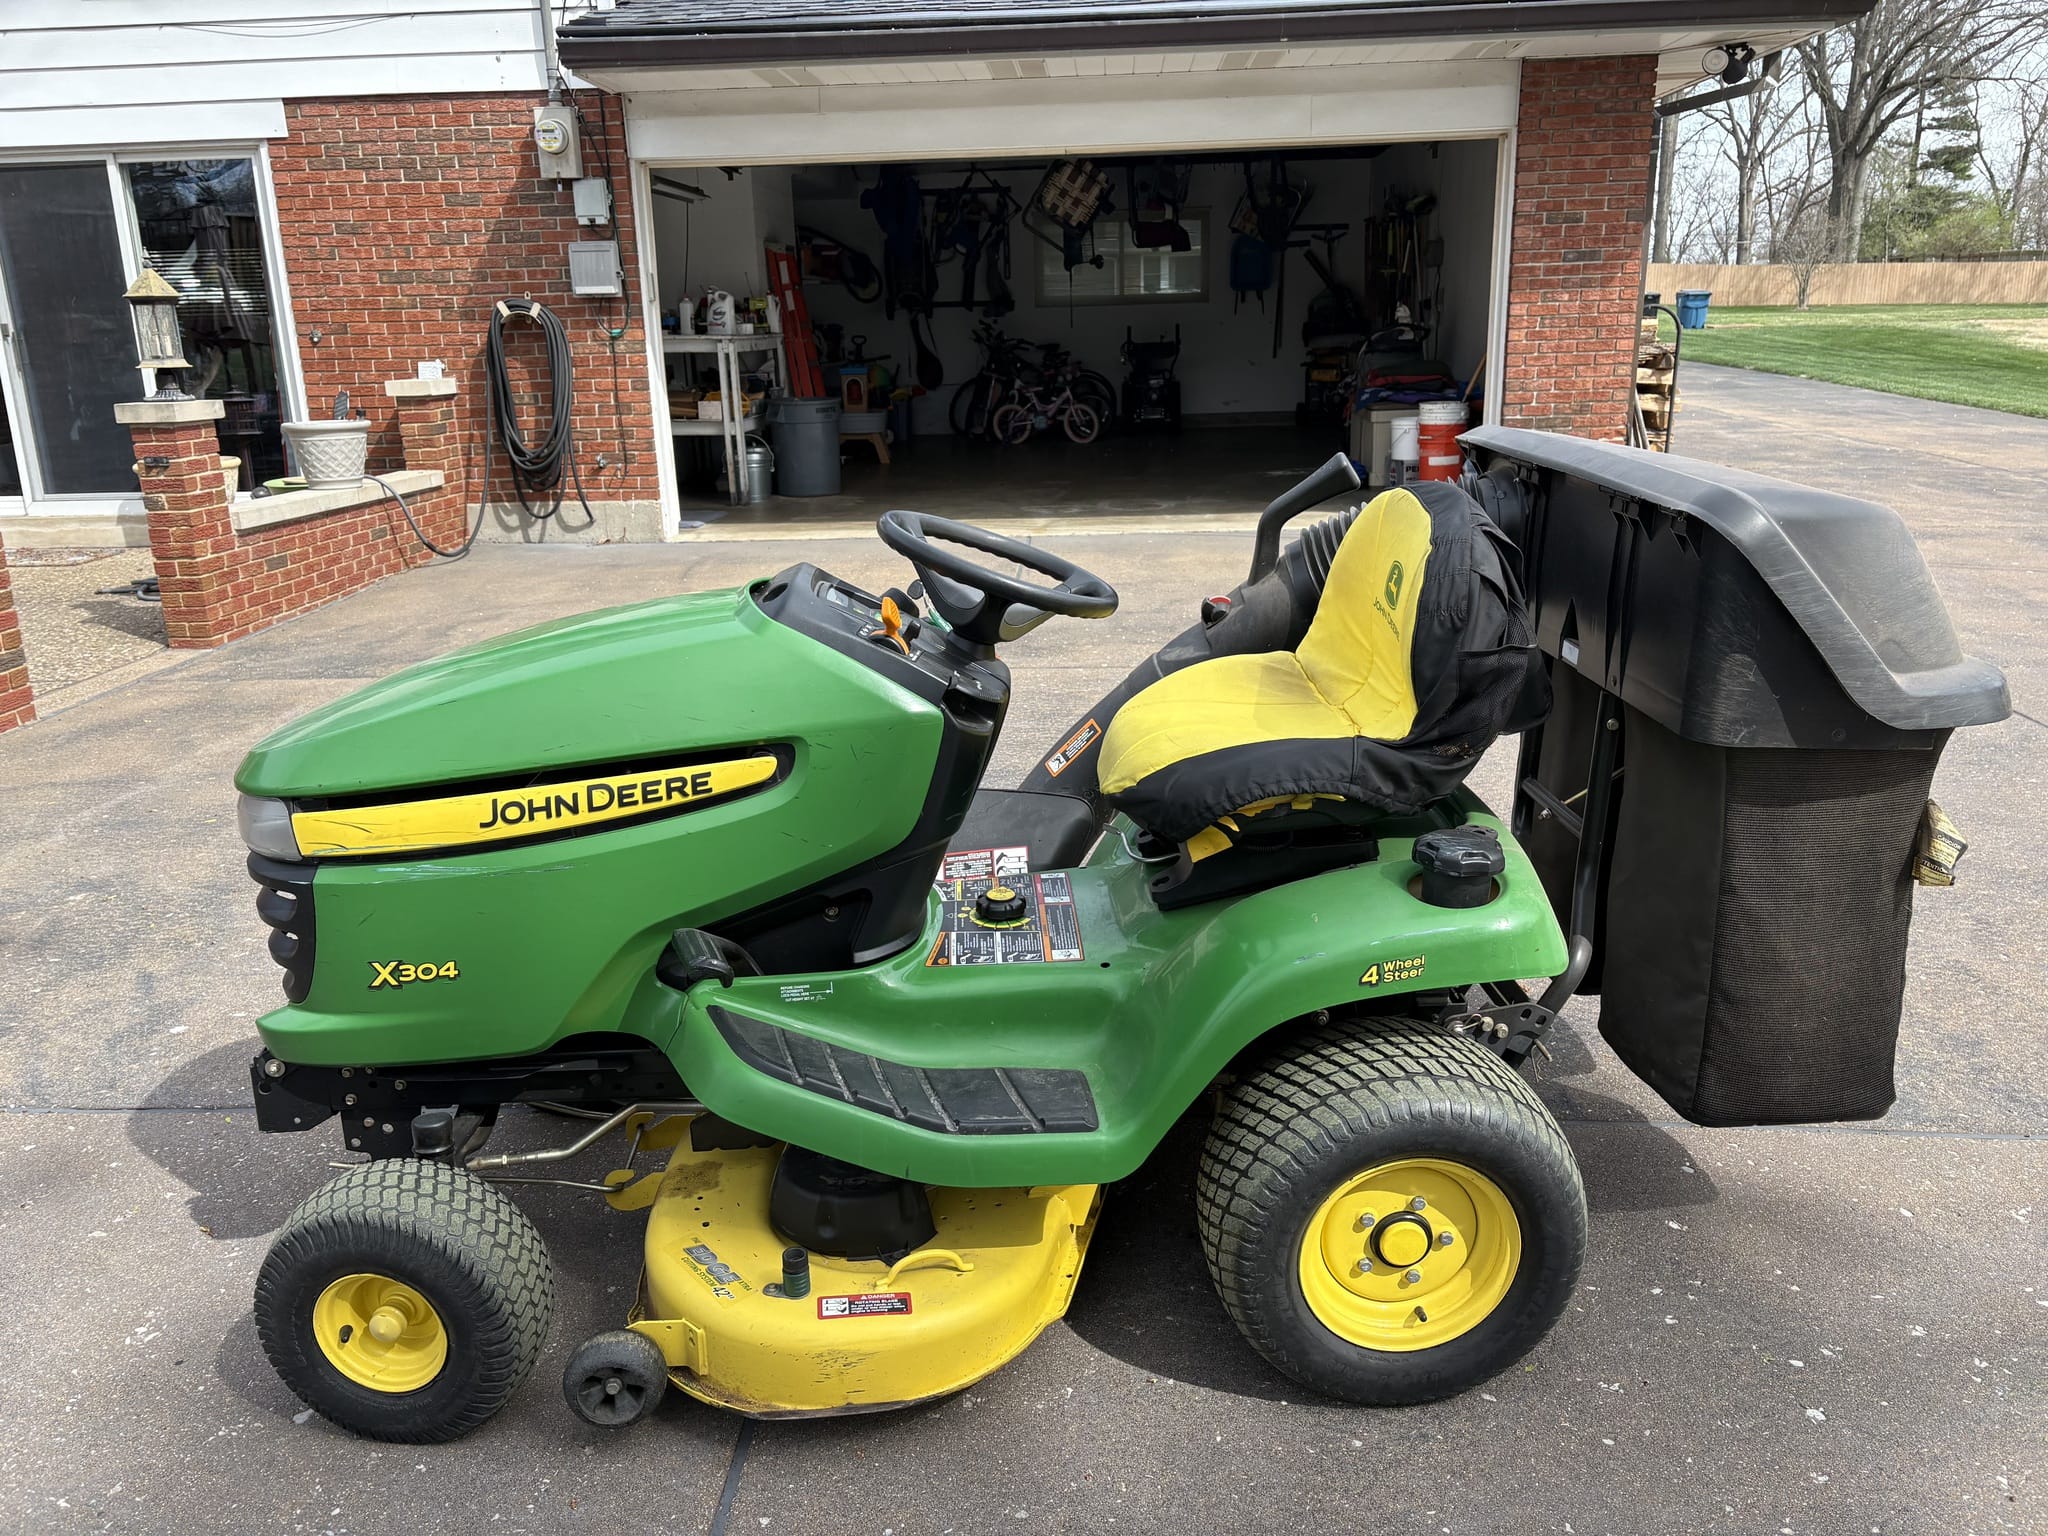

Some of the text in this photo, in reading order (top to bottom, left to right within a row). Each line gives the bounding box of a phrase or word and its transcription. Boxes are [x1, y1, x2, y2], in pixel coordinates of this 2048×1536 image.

[479, 771, 713, 829] JOHN DEERE
[369, 960, 459, 987] X304
[1360, 954, 1425, 984] 4 Wheel
[1383, 967, 1425, 983] Steer
[683, 1243, 742, 1286] EDGE
[697, 1271, 718, 1288] SYSTEM
[712, 1286, 735, 1299] 42"
